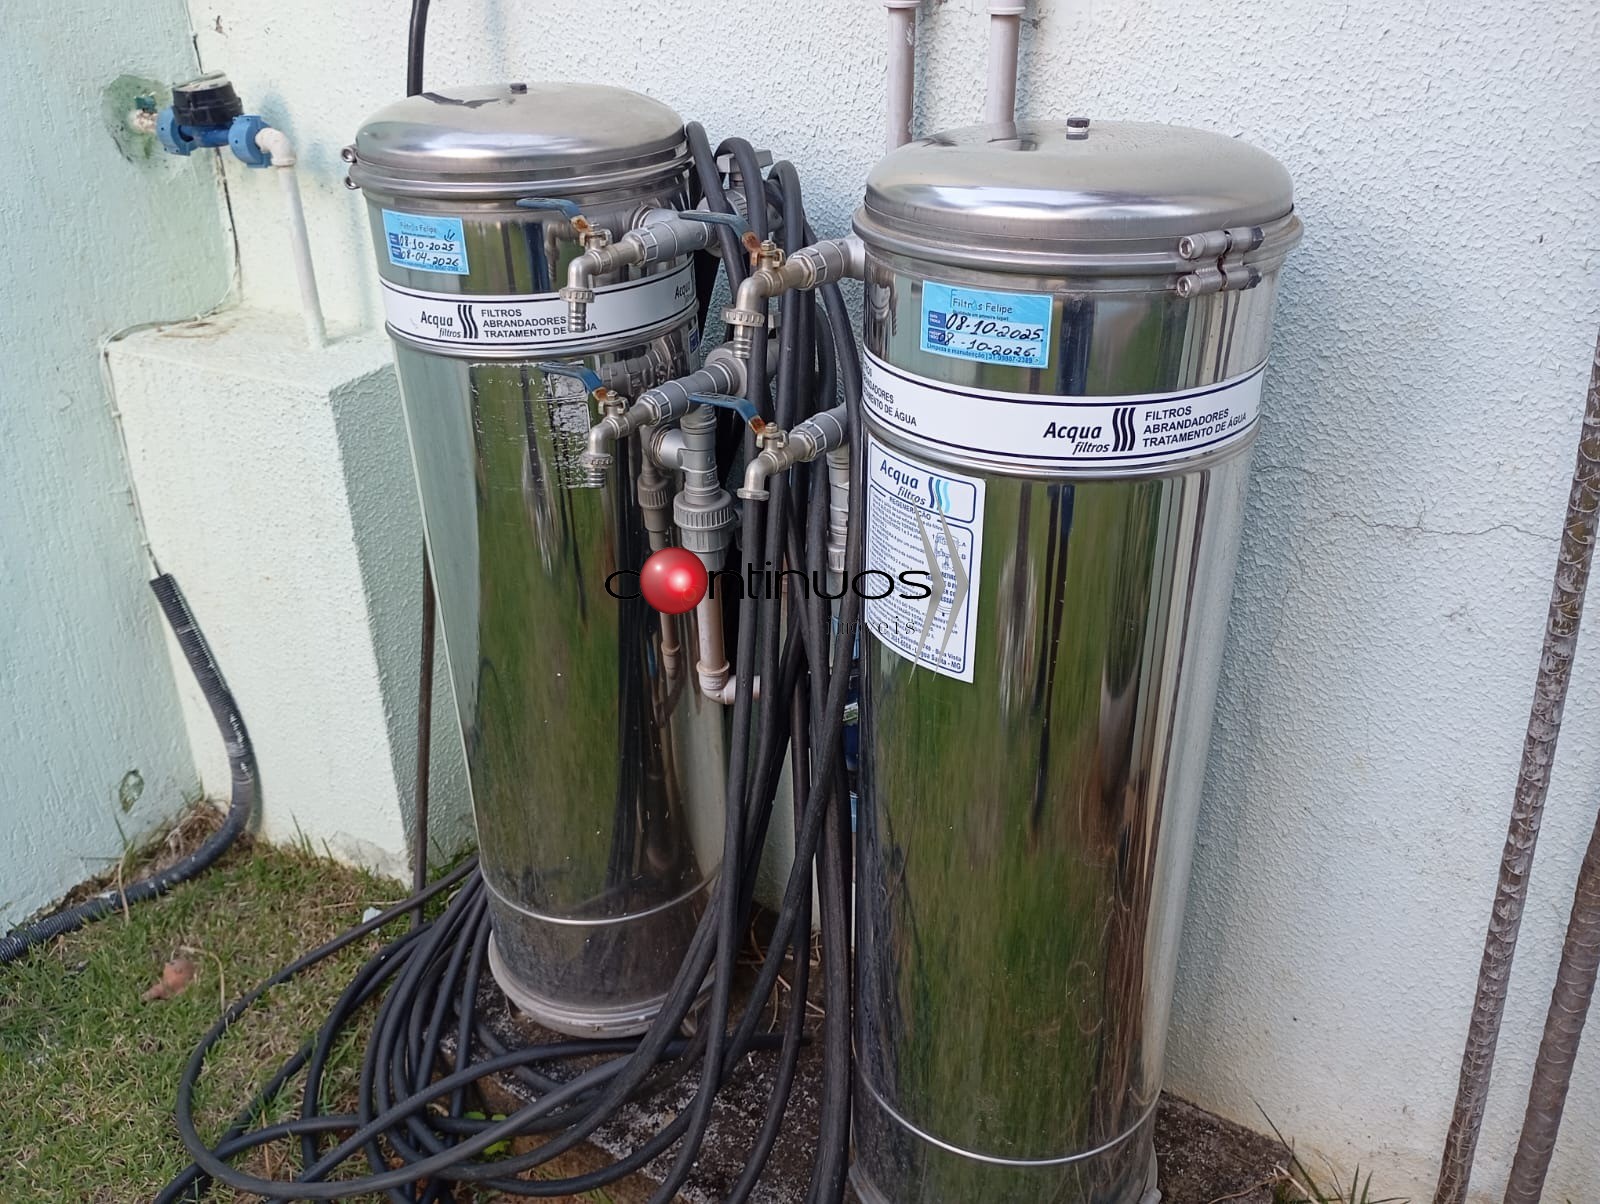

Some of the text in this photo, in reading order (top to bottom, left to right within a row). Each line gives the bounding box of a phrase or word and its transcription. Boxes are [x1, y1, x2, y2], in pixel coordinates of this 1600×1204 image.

[481, 308, 522, 317] FILTROS
[986, 302, 1013, 315] Felipe
[420, 311, 453, 328] Acqua
[482, 316, 567, 328] ABRANDADORES
[438, 327, 461, 339] filtros
[484, 328, 551, 338] TRATAMENTO
[554, 327, 567, 335] DE
[885, 404, 893, 416] DE
[895, 408, 917, 427] ÁGUA
[1143, 408, 1229, 435] ABRANDADORES
[1145, 405, 1192, 422] FILTROS
[1043, 421, 1102, 443] Acqua
[1142, 412, 1247, 448] TRATAMENTO DE ÁGUA
[1072, 441, 1111, 456] filtros
[879, 459, 919, 490] Acqua
[897, 486, 926, 506] filtros
[889, 496, 931, 521] REGENERÇÃO
